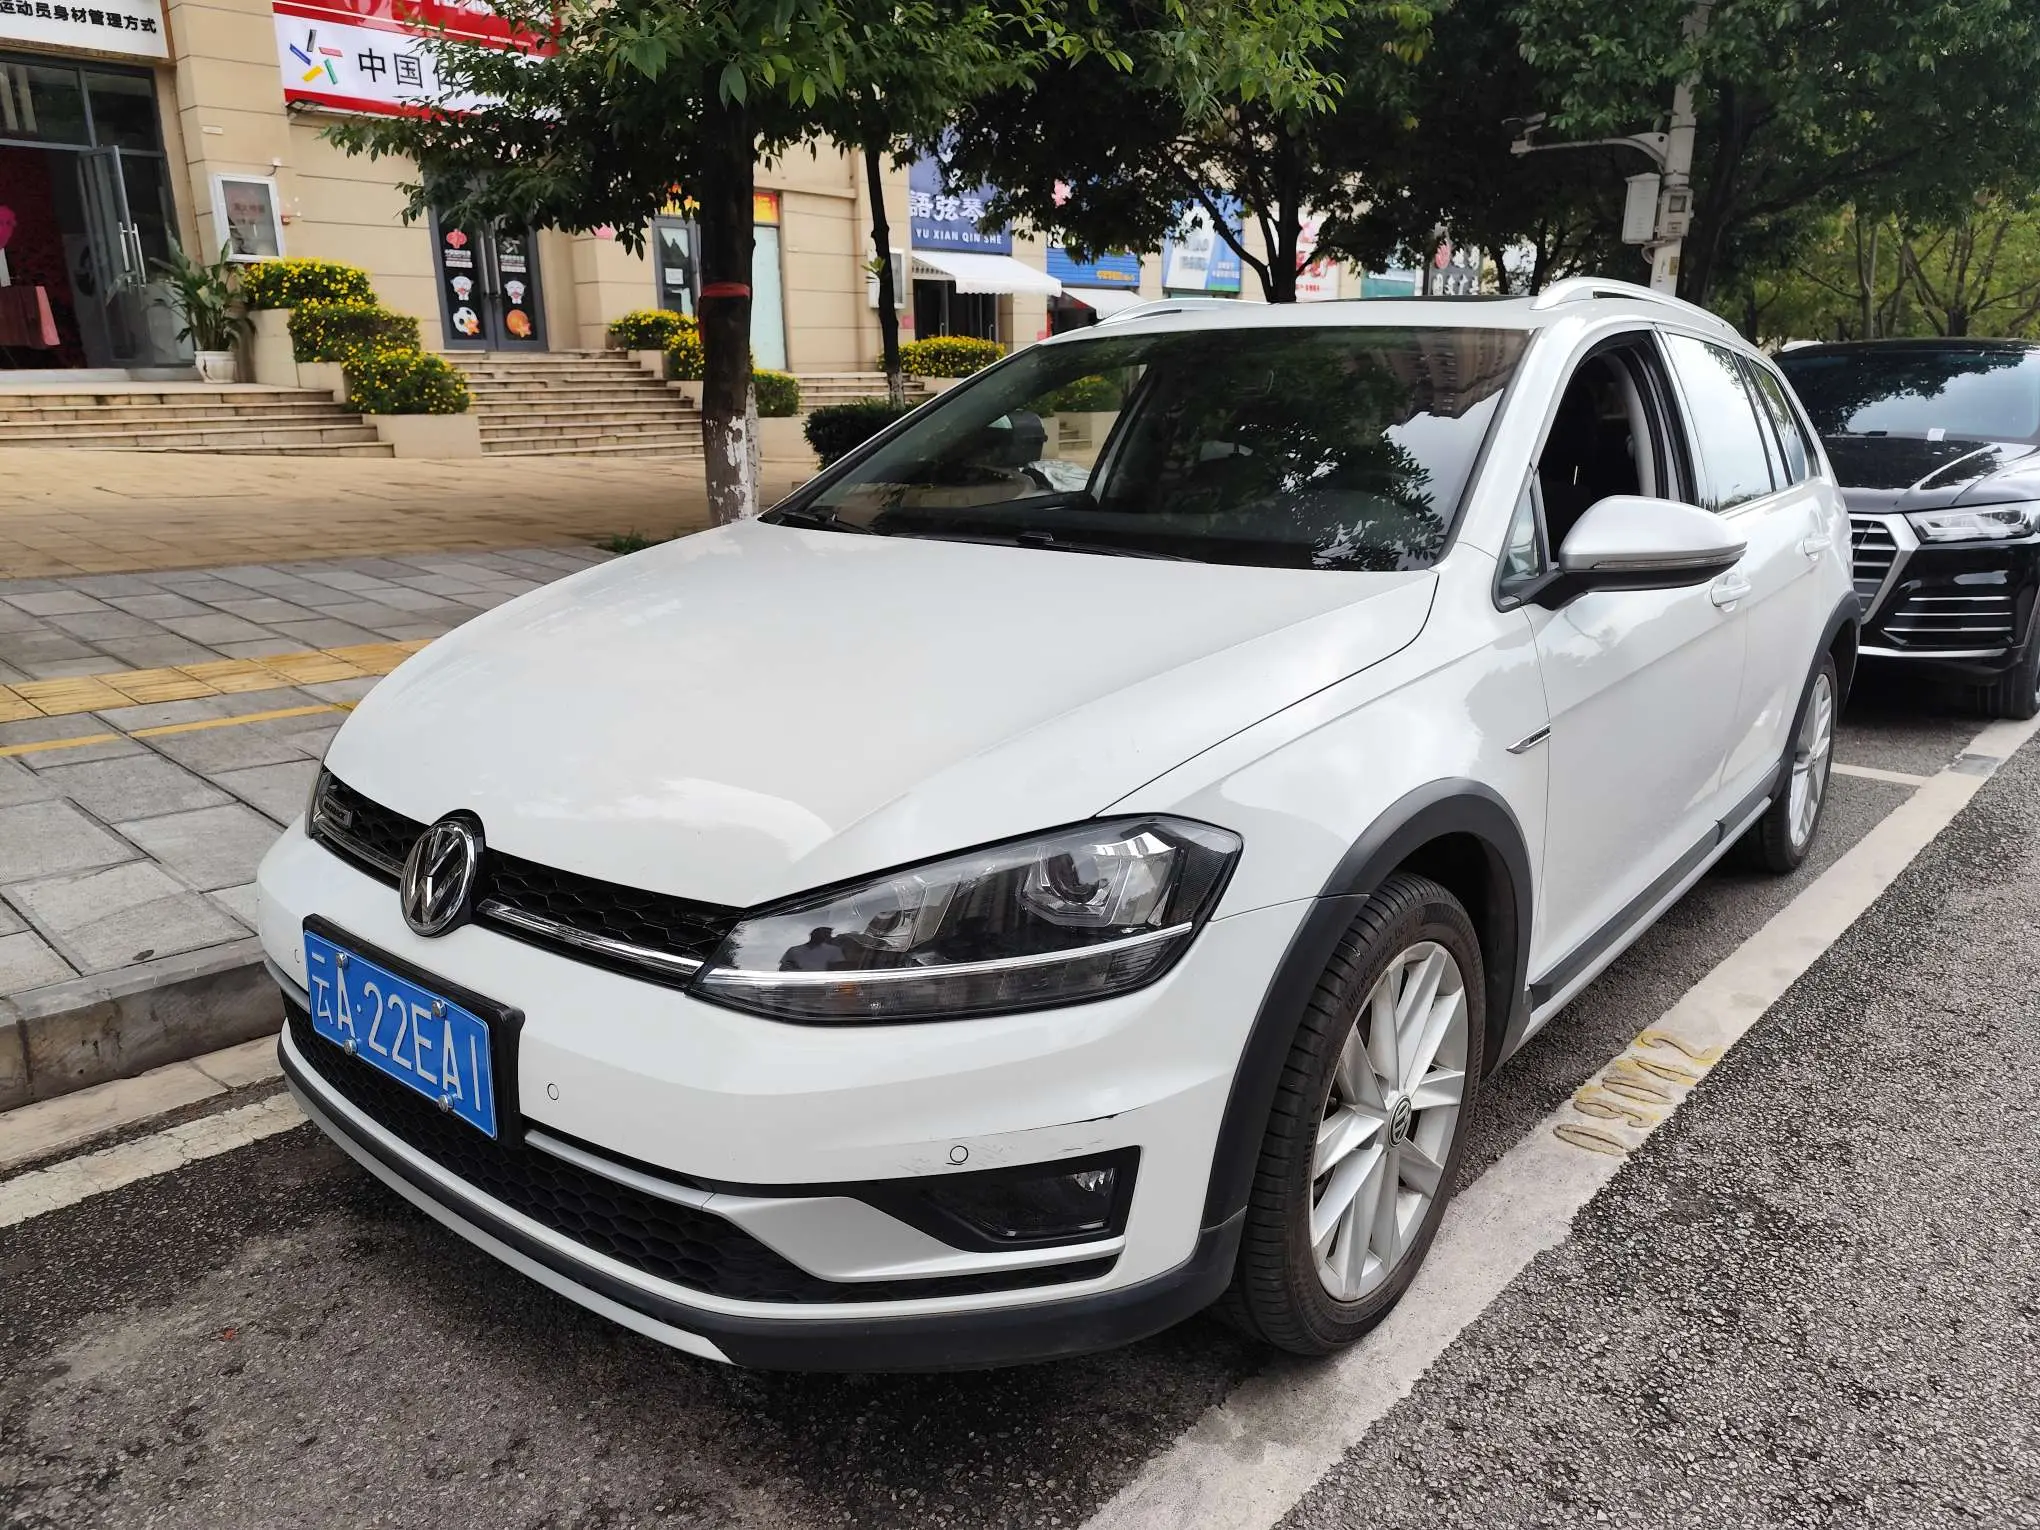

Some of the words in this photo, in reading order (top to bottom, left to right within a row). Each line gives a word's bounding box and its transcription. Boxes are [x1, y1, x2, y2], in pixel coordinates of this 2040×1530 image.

[915, 228, 930, 239] YU
[933, 230, 959, 241] XIAN
[962, 232, 981, 243] QIN
